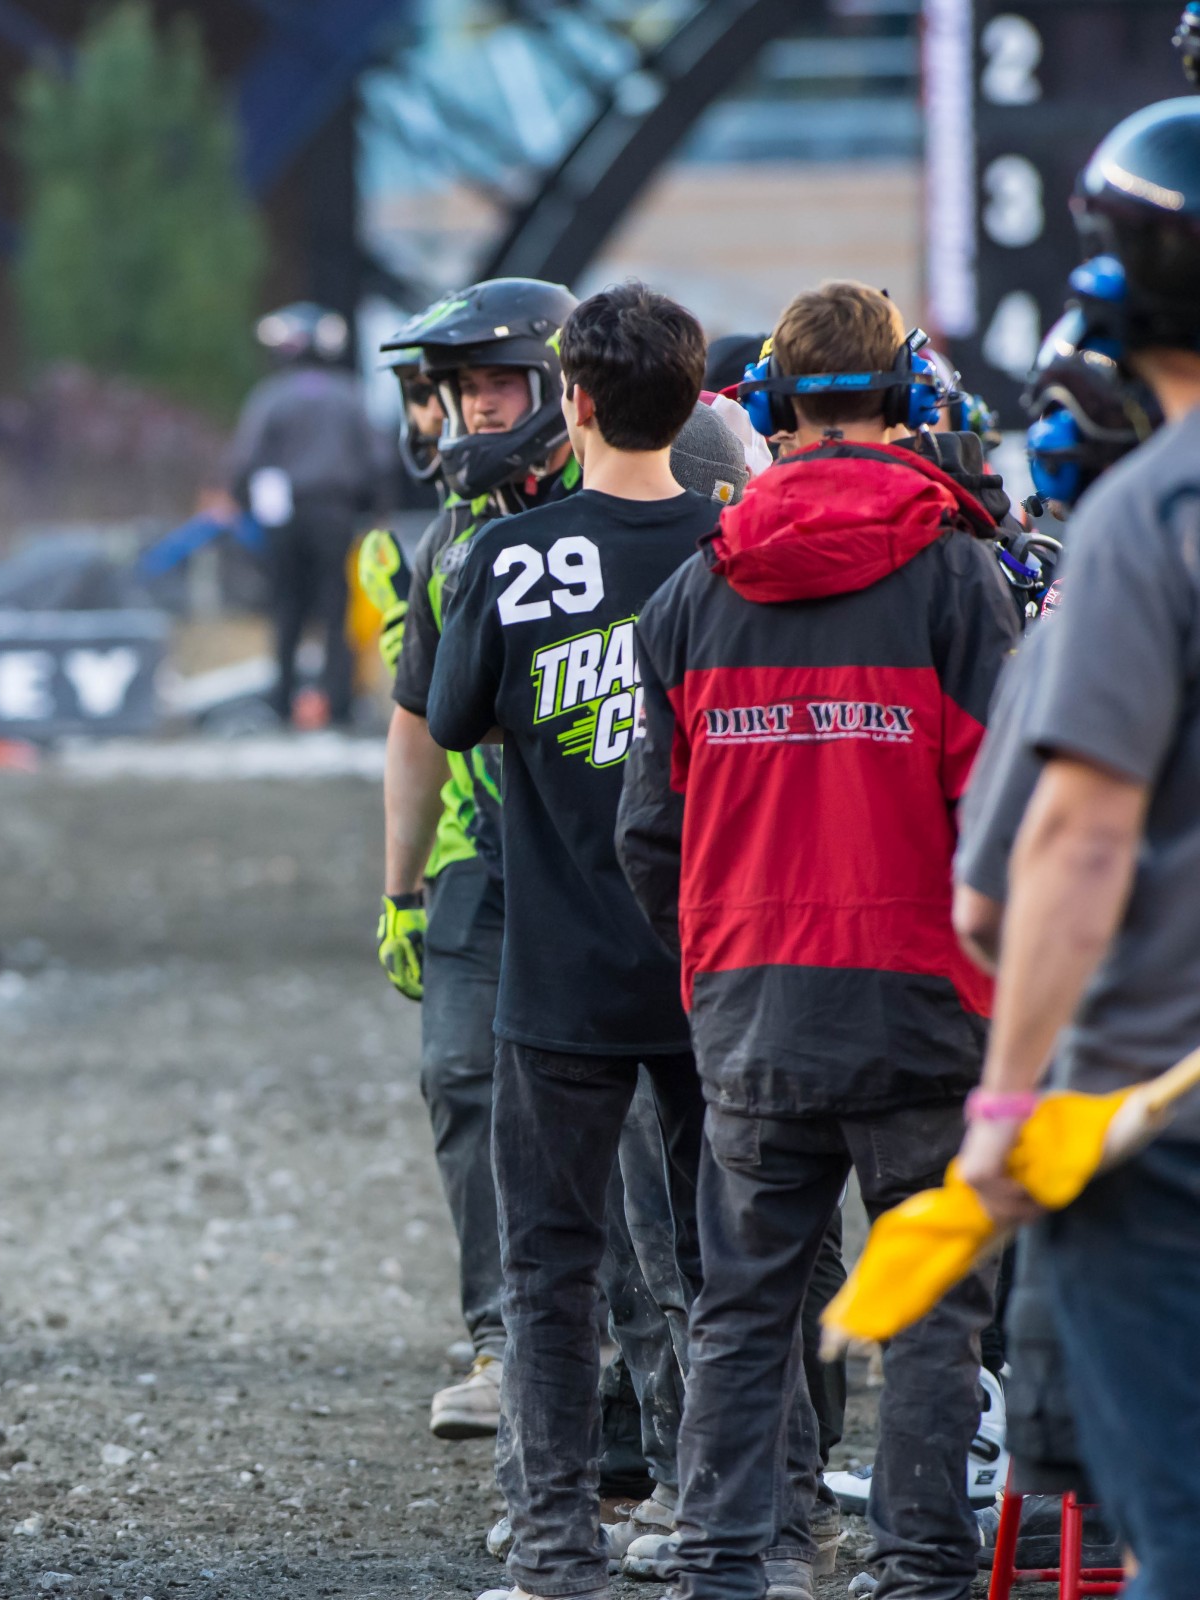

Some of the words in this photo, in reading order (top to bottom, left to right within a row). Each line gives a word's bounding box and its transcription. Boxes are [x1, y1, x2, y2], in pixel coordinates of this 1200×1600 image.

[981, 12, 1043, 105] 2
[982, 153, 1045, 249] 3
[493, 535, 604, 626] 29
[535, 622, 642, 718] TRA
[704, 704, 793, 736] DIRT
[807, 702, 915, 733] WURX
